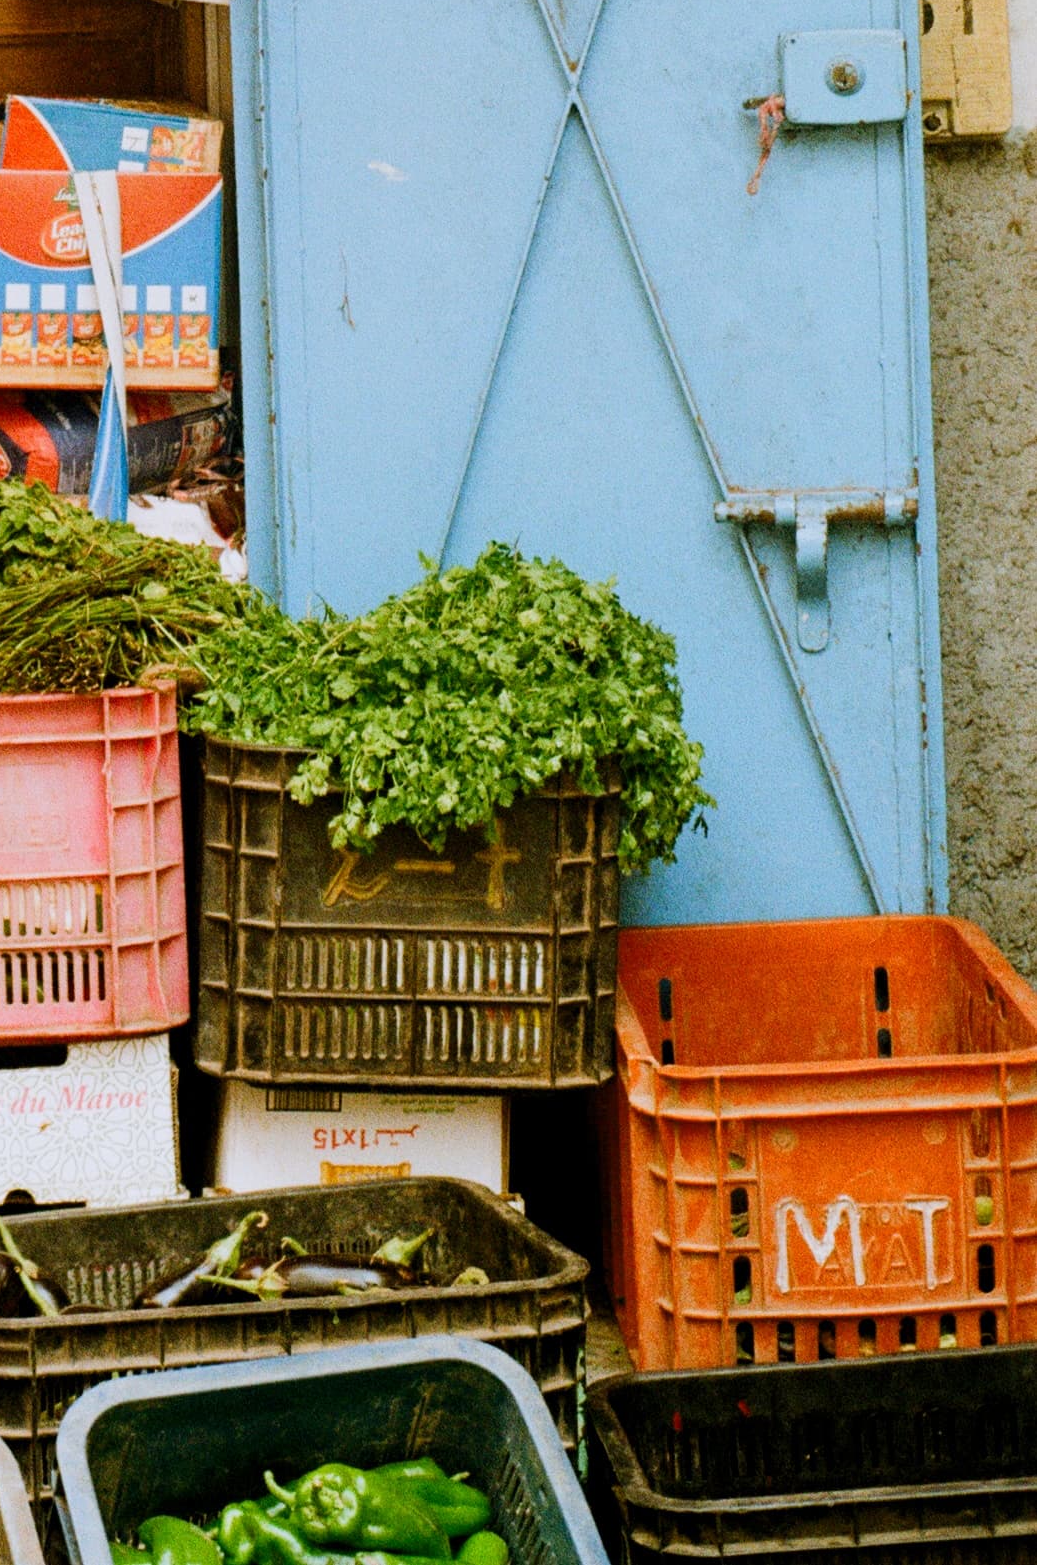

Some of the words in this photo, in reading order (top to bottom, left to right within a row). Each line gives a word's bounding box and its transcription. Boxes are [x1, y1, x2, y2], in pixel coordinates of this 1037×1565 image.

[11, 1086, 46, 1115] du
[56, 1084, 148, 1113] Maroc
[314, 1127, 368, 1150] 1x15
